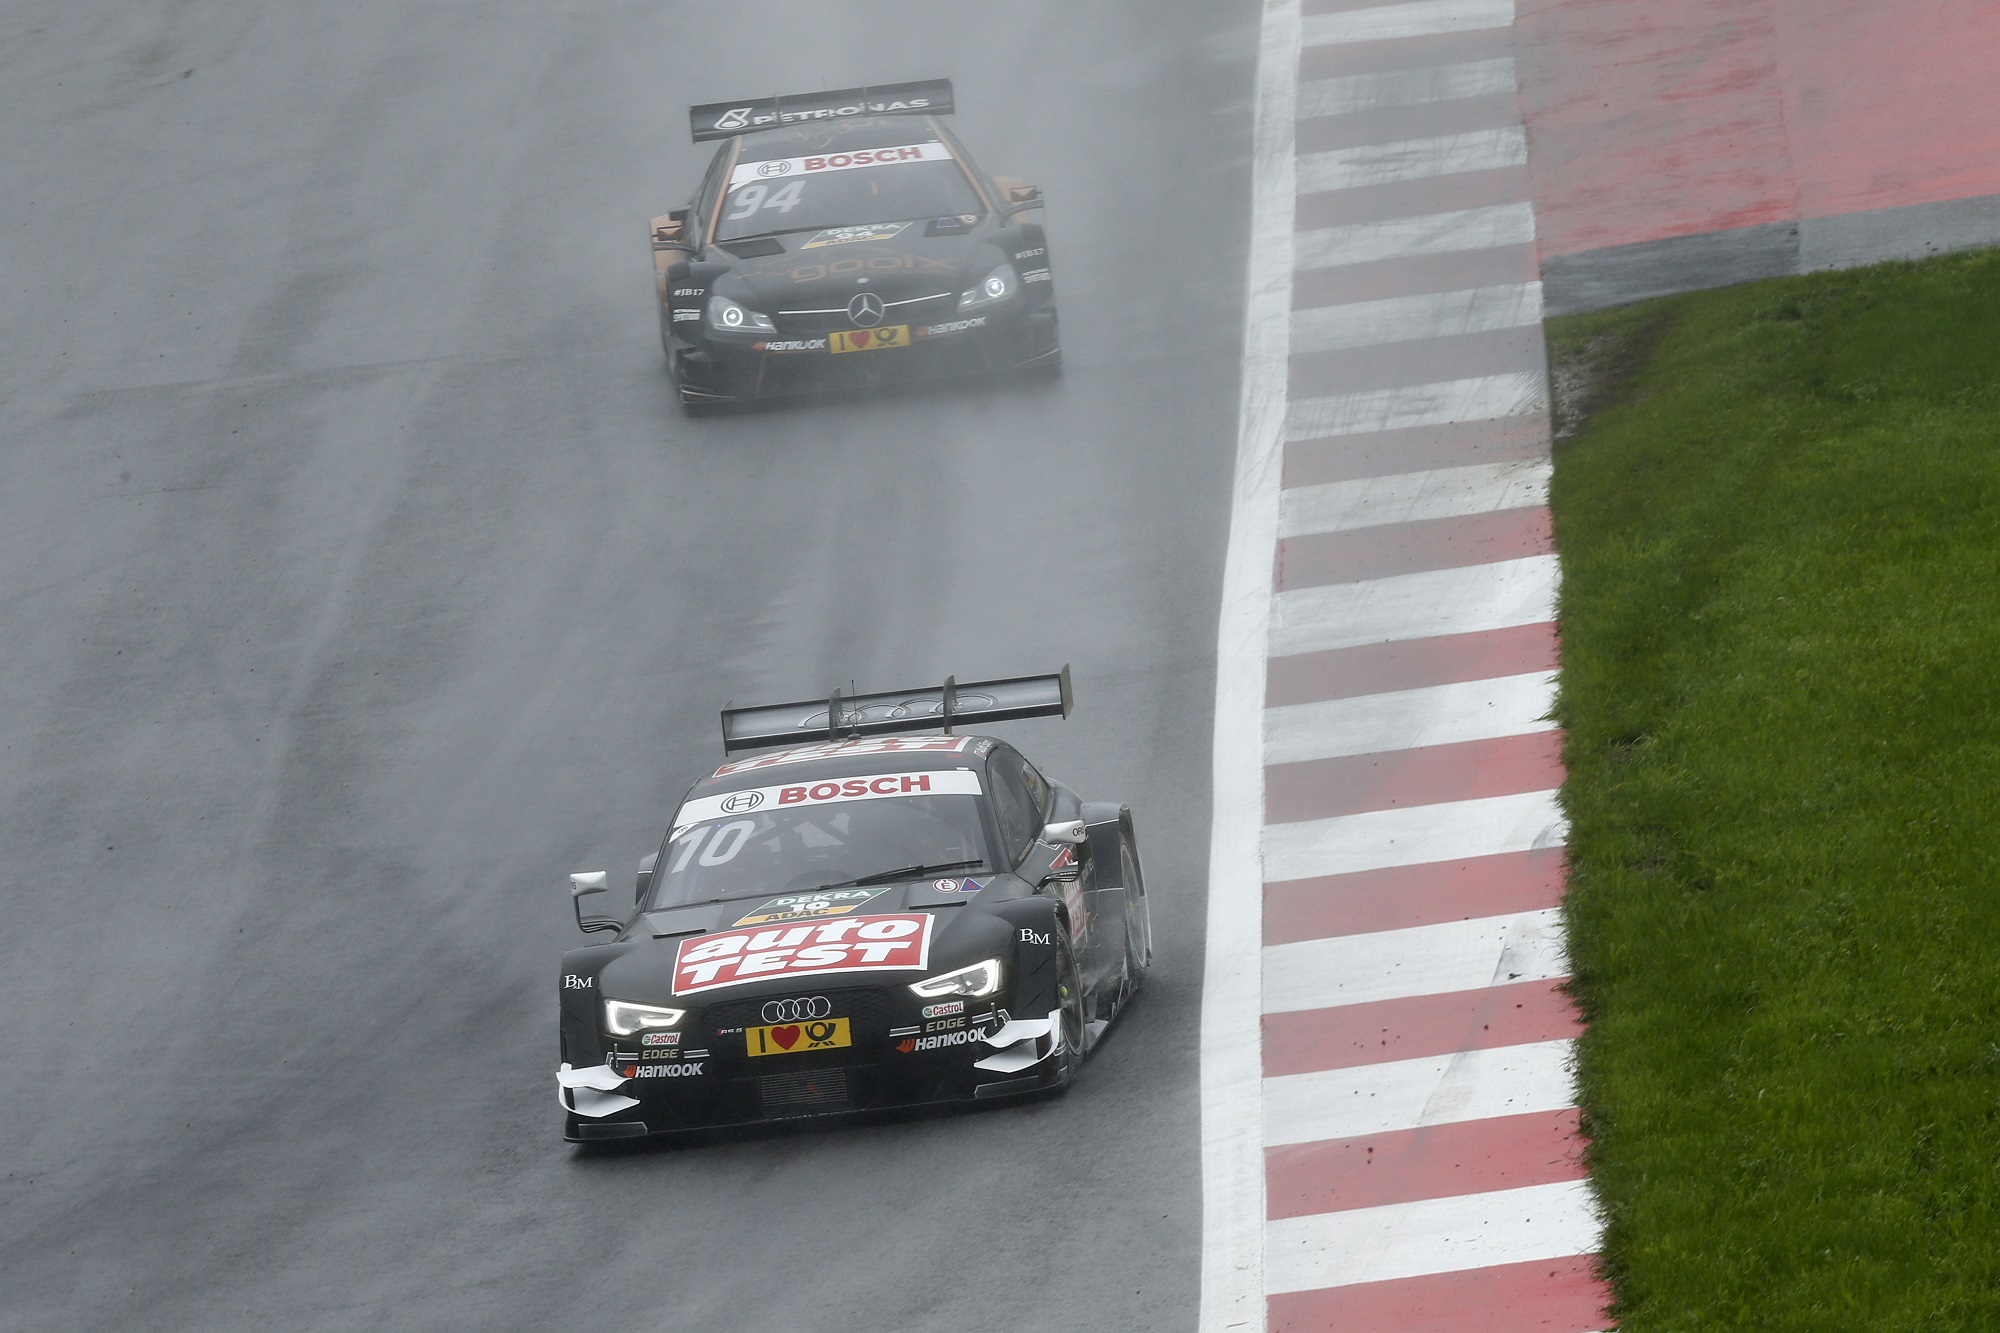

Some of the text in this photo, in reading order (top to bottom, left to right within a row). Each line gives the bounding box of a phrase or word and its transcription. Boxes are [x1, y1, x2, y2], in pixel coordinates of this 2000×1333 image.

[754, 99, 930, 125] PETRONAS
[804, 147, 923, 171] BOSCH
[727, 180, 807, 220] 94
[827, 224, 902, 235] DEKRA
[789, 254, 957, 284] gooix
[674, 288, 705, 296] #JB17
[778, 775, 931, 805] BOSCH
[671, 820, 756, 874] 10
[776, 889, 872, 906] DEKRA
[789, 900, 831, 912] 10
[764, 908, 829, 921] ADAC
[681, 918, 920, 964] auto
[681, 941, 911, 985] TEST
[933, 1003, 963, 1016] Castrol
[926, 1017, 966, 1033] EDGE
[651, 1034, 679, 1044] Castrol
[642, 1049, 680, 1060] EDGE
